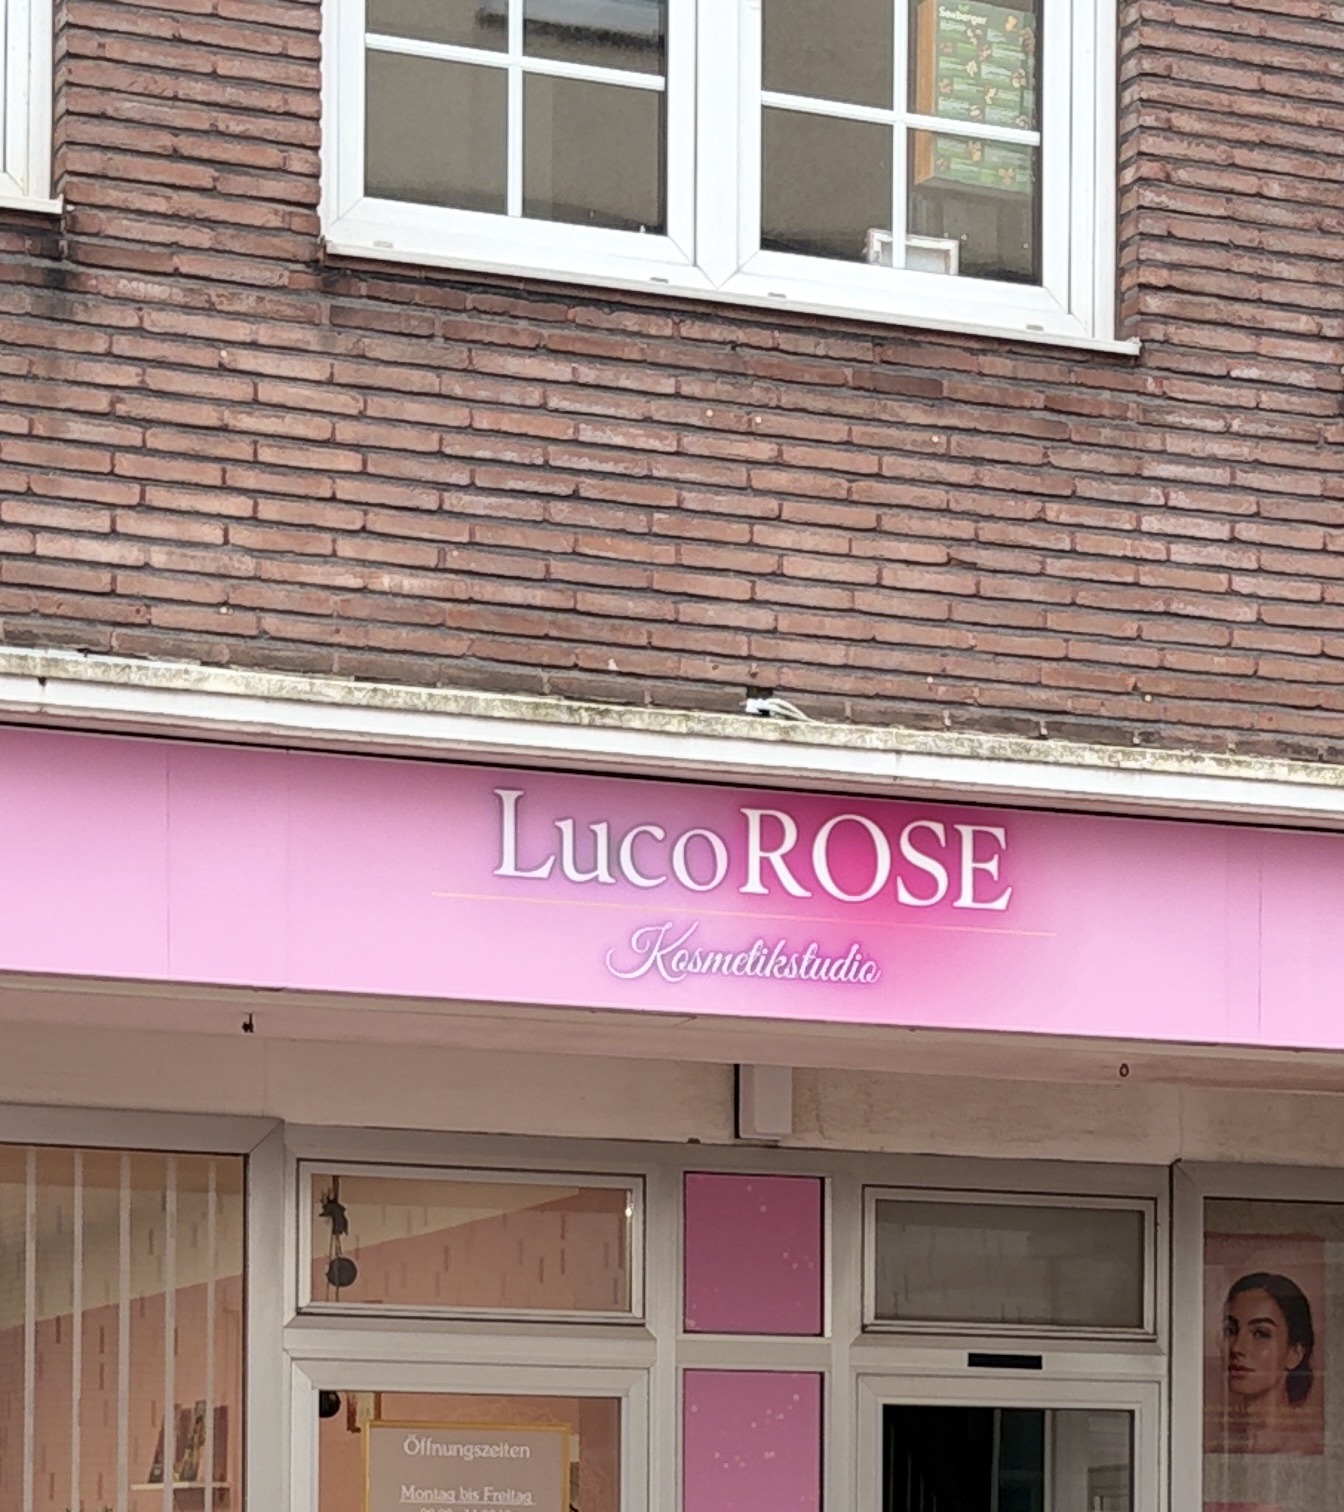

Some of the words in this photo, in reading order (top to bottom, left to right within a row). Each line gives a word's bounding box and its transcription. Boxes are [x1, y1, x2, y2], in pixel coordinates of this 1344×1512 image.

[938, 5, 987, 25] Seeberger
[491, 787, 1014, 912] LucoROSE
[605, 920, 882, 984] Kosmetikstudio
[403, 1434, 531, 1461] Öffnungszeiten
[400, 1485, 455, 1503] Montag
[459, 1486, 480, 1501] bis
[483, 1487, 533, 1505] Freitag
